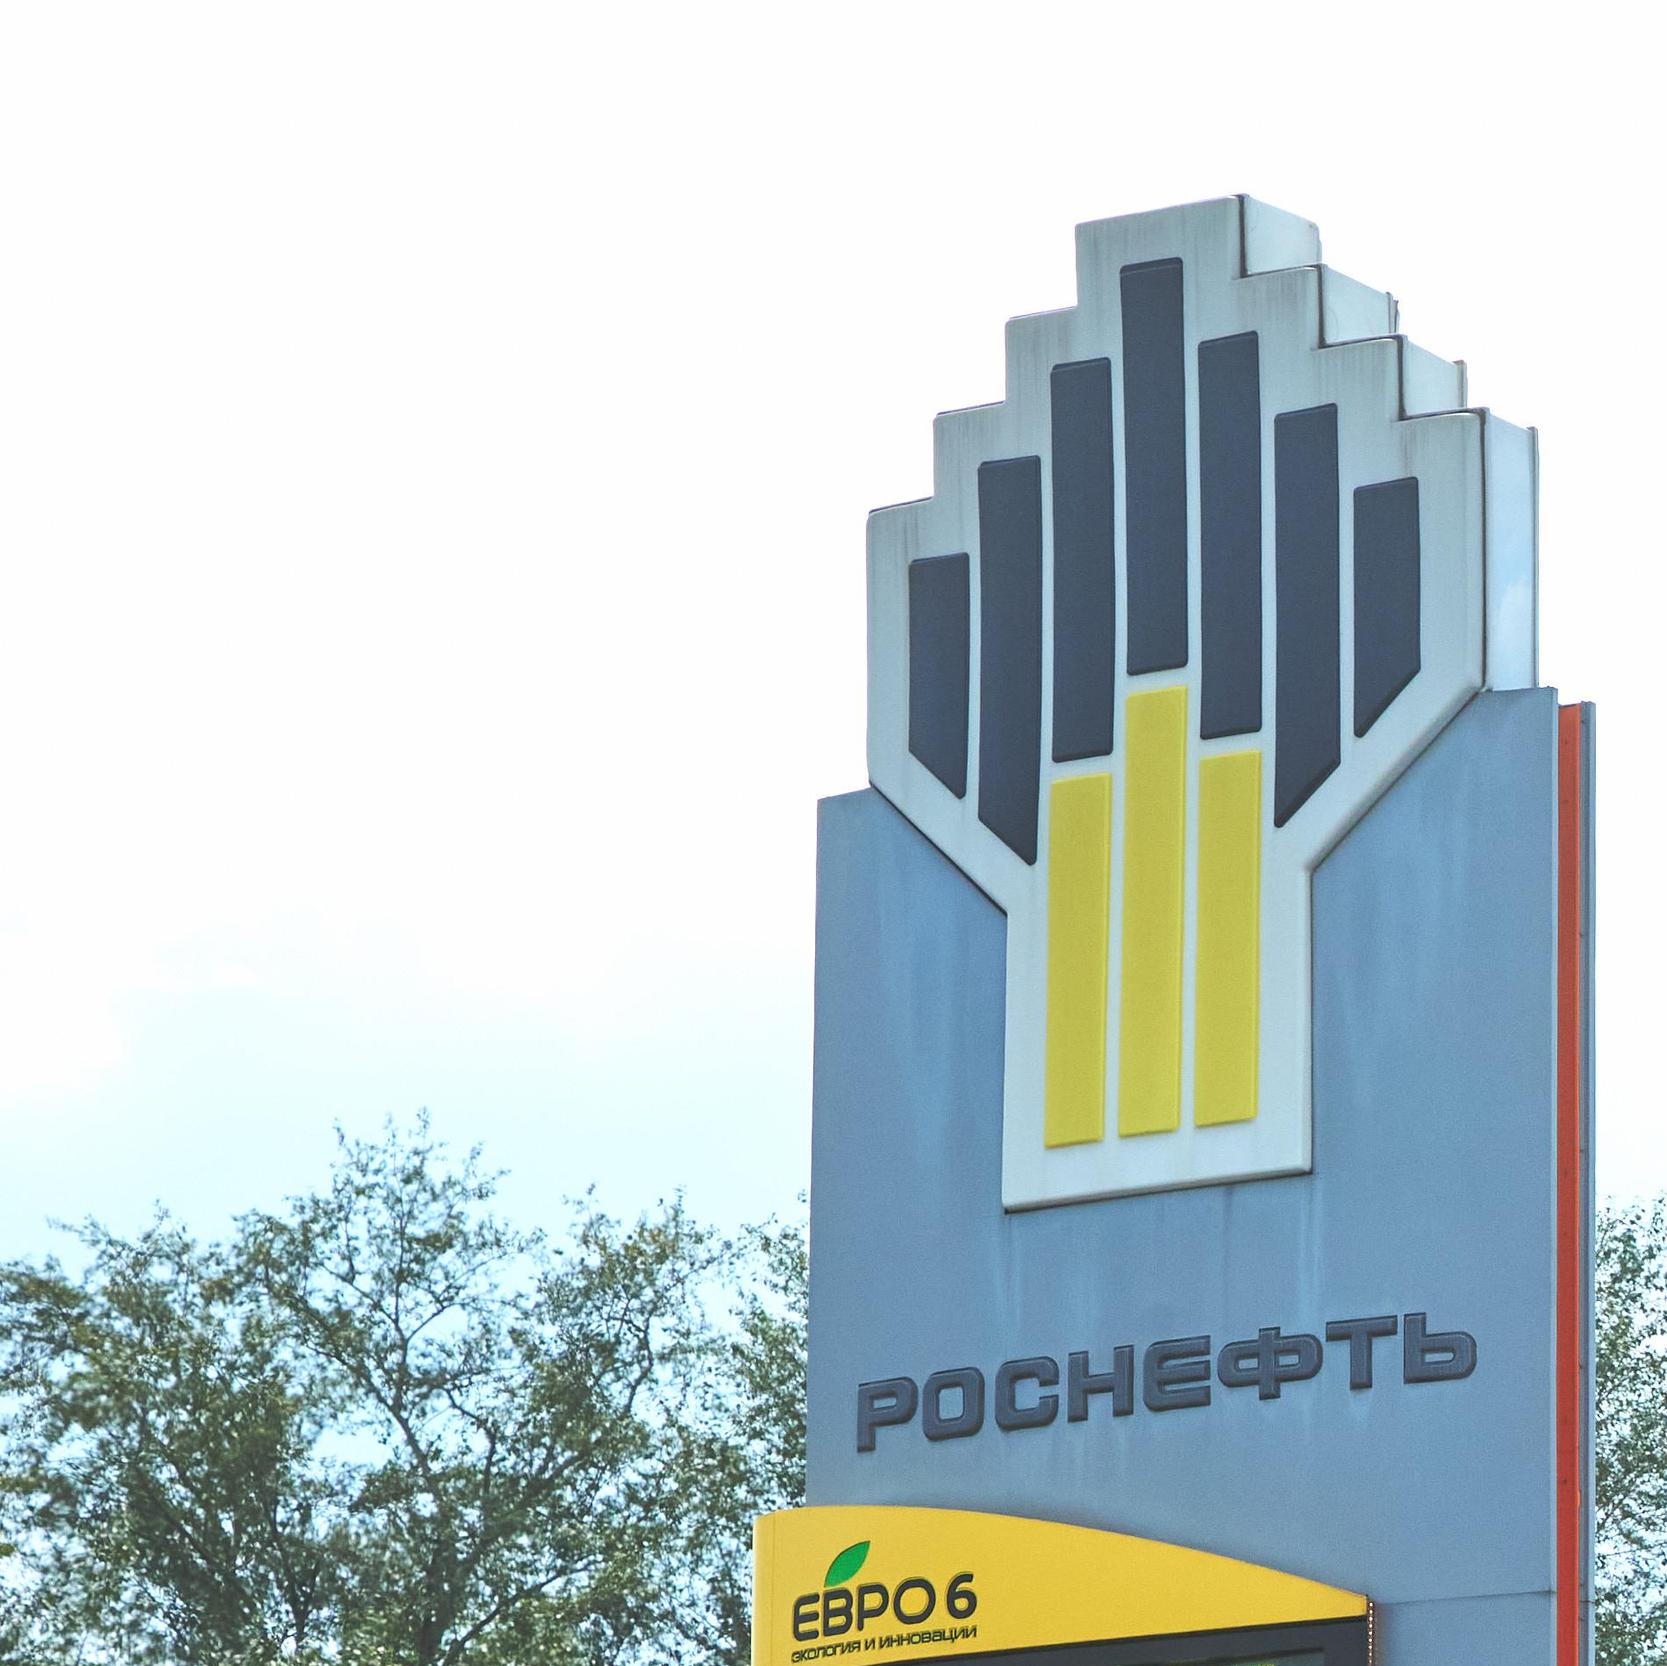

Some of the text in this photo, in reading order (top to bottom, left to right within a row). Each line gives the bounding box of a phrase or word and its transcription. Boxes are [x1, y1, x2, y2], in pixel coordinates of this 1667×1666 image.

[856, 1312, 1478, 1453] РОСНЕФТЬ
[793, 1571, 978, 1642] ЕВРО 6
